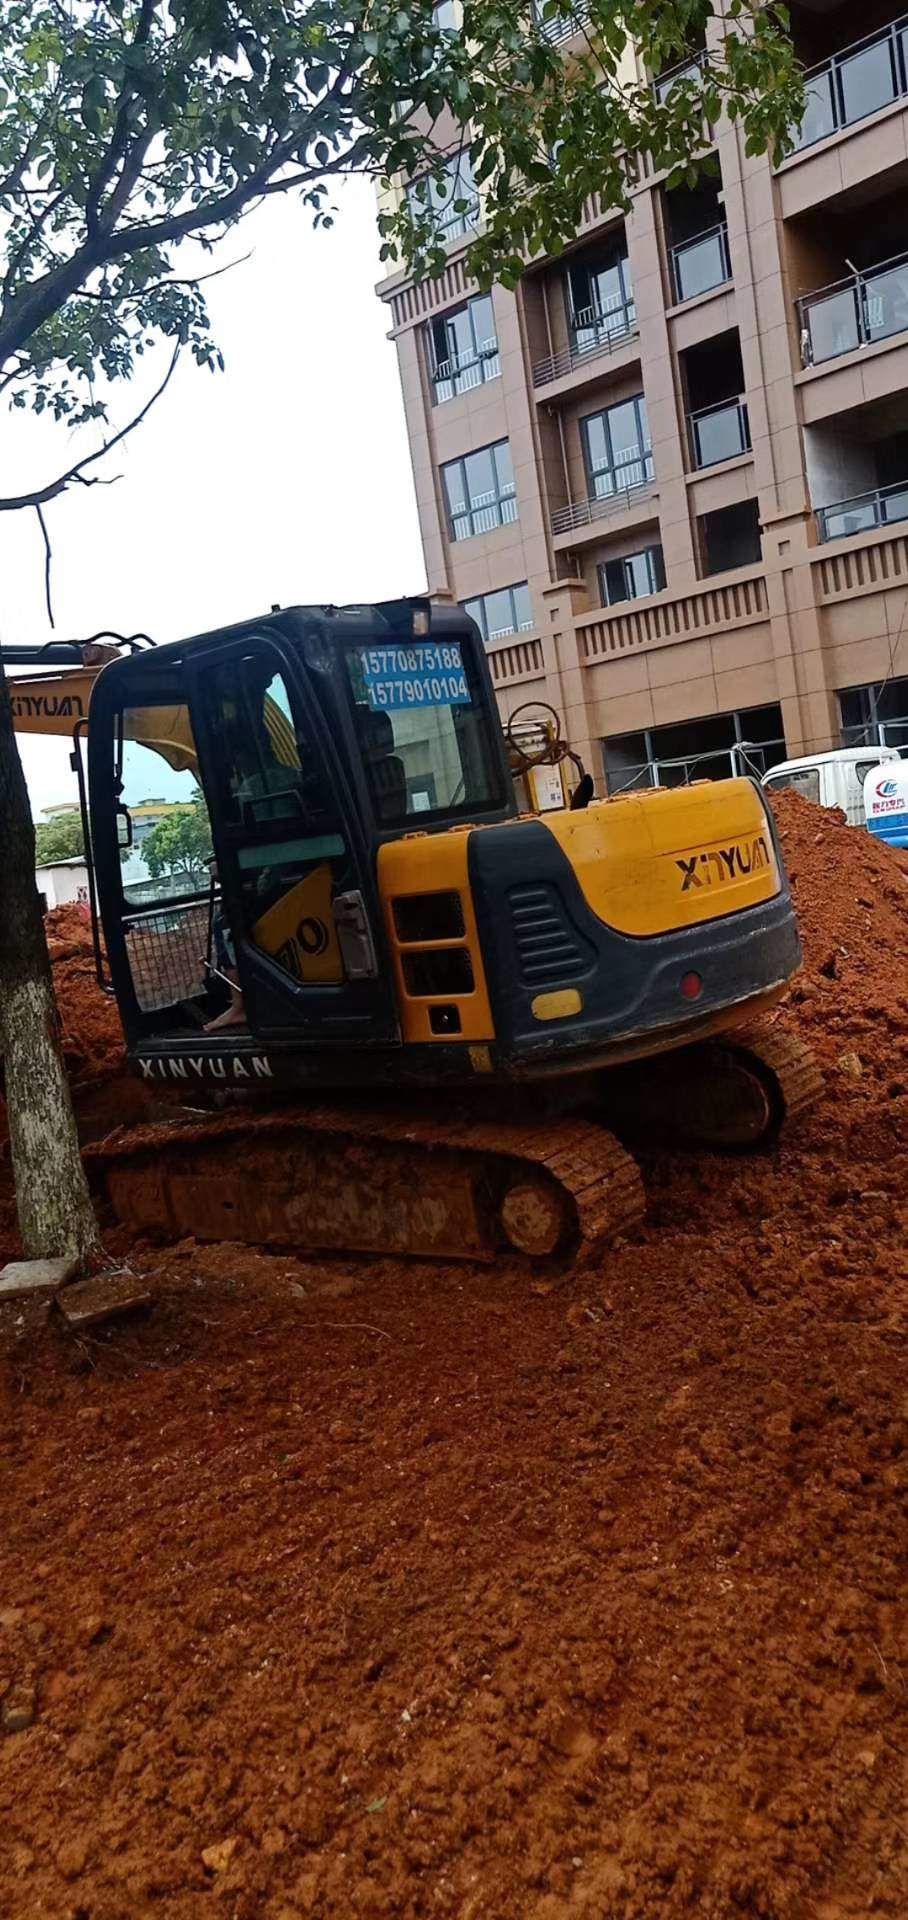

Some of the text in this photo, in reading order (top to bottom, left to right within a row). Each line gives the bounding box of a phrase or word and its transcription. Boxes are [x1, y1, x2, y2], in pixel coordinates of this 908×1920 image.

[361, 647, 461, 675] 15770875188
[368, 676, 467, 705] 15779010104
[675, 836, 770, 891] XINYUAN
[138, 1056, 273, 1078] XINYUAN
